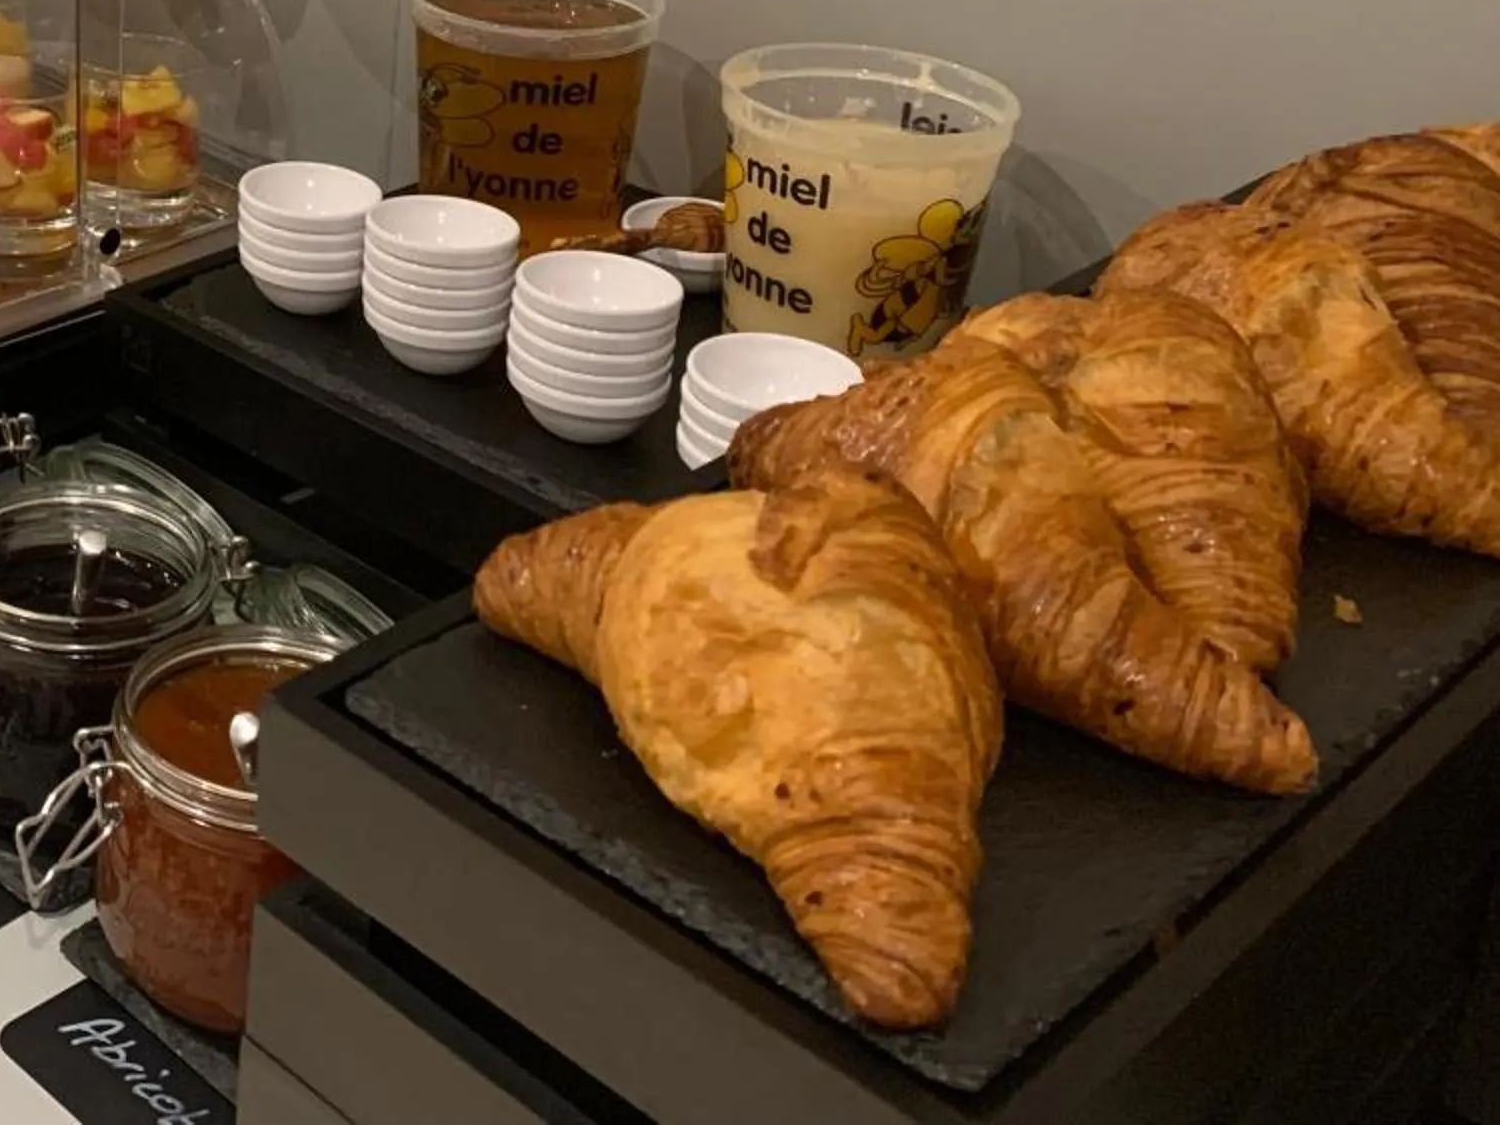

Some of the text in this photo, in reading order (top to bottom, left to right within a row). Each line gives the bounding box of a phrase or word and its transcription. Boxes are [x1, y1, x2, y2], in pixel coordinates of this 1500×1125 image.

[510, 72, 598, 107] miel
[512, 123, 563, 155] de
[449, 153, 579, 202] l'yonne
[747, 157, 830, 210] miel
[747, 210, 791, 254] de
